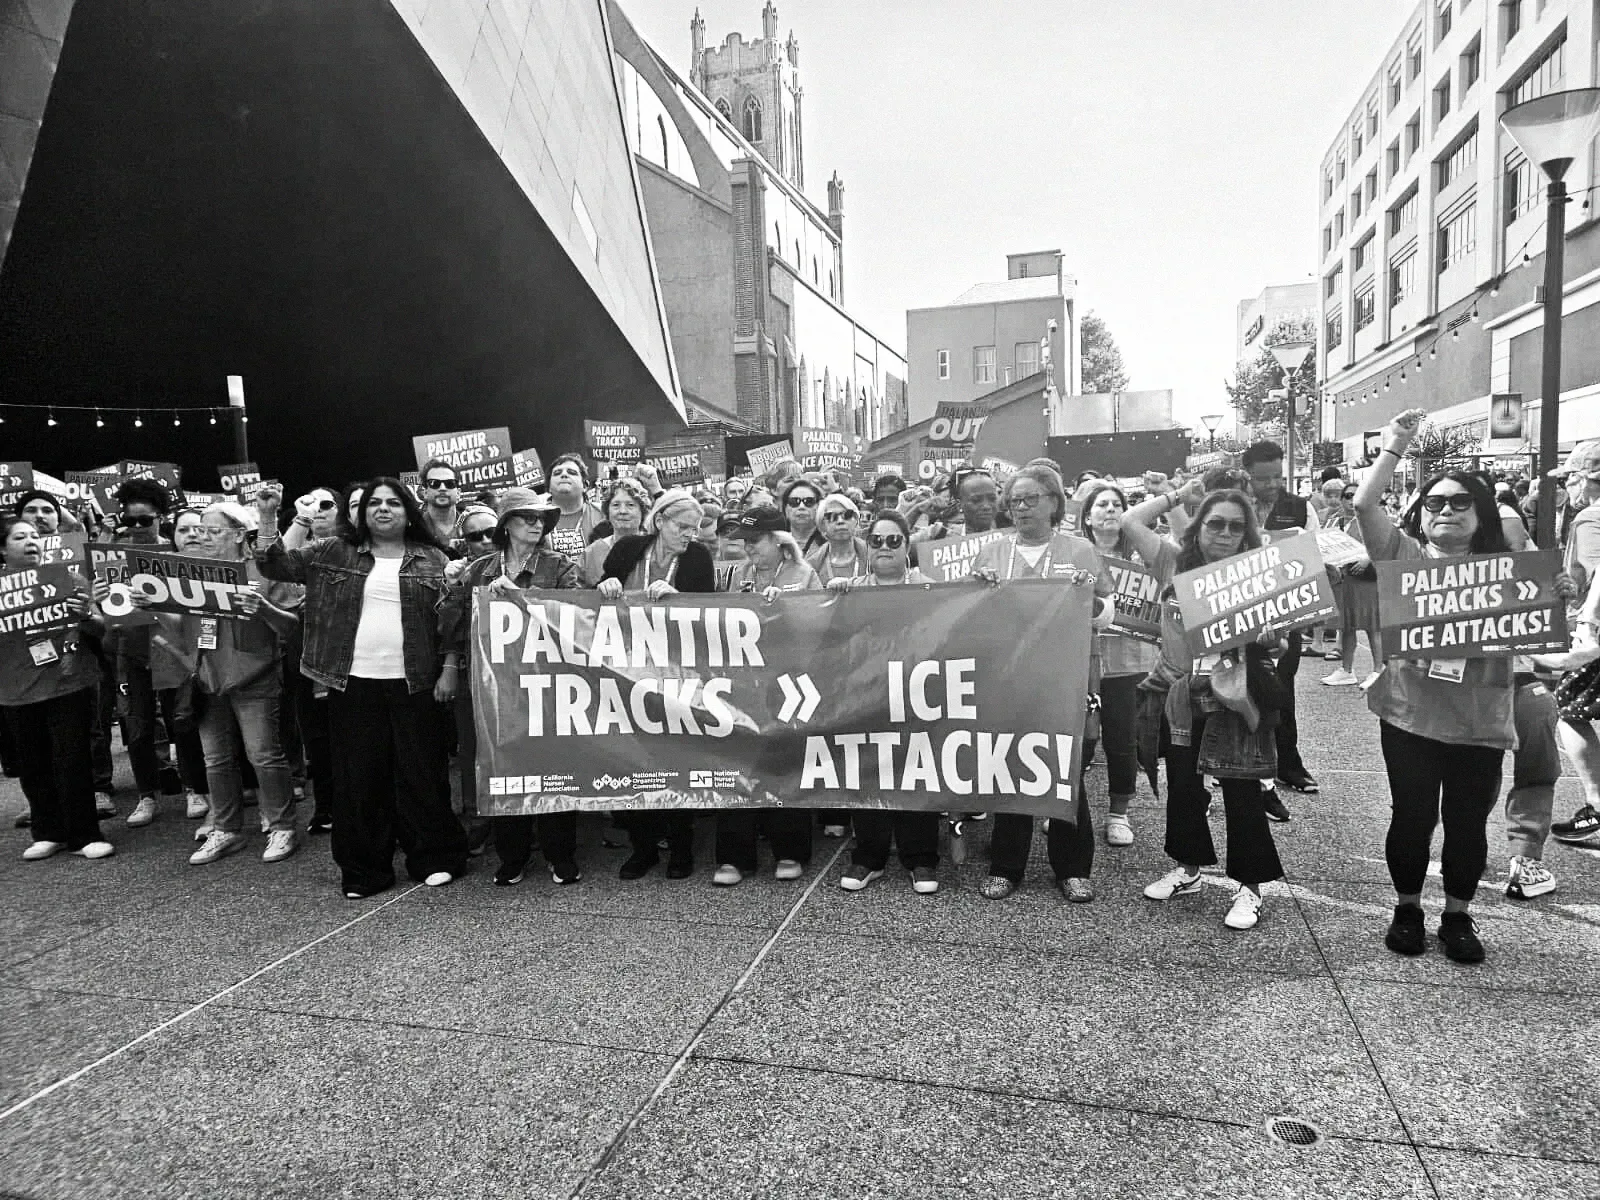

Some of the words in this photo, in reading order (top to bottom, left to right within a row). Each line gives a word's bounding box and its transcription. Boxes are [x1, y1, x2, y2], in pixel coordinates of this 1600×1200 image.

[592, 426, 629, 436] PALANTIR
[596, 437, 625, 446] TRACKS
[803, 432, 842, 443] PALANTIR
[427, 432, 487, 457] PALANTIR
[605, 449, 640, 459] ATTACKS!
[808, 442, 839, 453] TRACKS
[459, 462, 508, 485] TTACKS!
[818, 456, 852, 469] ATTACKS!
[65, 483, 97, 500] OU
[0, 569, 39, 592] NTIR
[136, 557, 238, 584] PALANTIR
[942, 557, 975, 581] TRA
[1193, 547, 1281, 599] PALANTIR
[1401, 557, 1514, 595] PALANTIR
[1207, 570, 1277, 615] TRACKS
[1415, 584, 1503, 618] TRACKS
[1202, 619, 1232, 648] ICE
[1235, 580, 1321, 635] ATTACKS!
[489, 600, 765, 668] PALANTIR
[1401, 625, 1434, 651] ICE
[1440, 609, 1552, 646] ATTACKS!
[519, 673, 734, 738] TRACKS
[888, 657, 977, 723] ICE
[800, 729, 1074, 801] ATTACKS!
